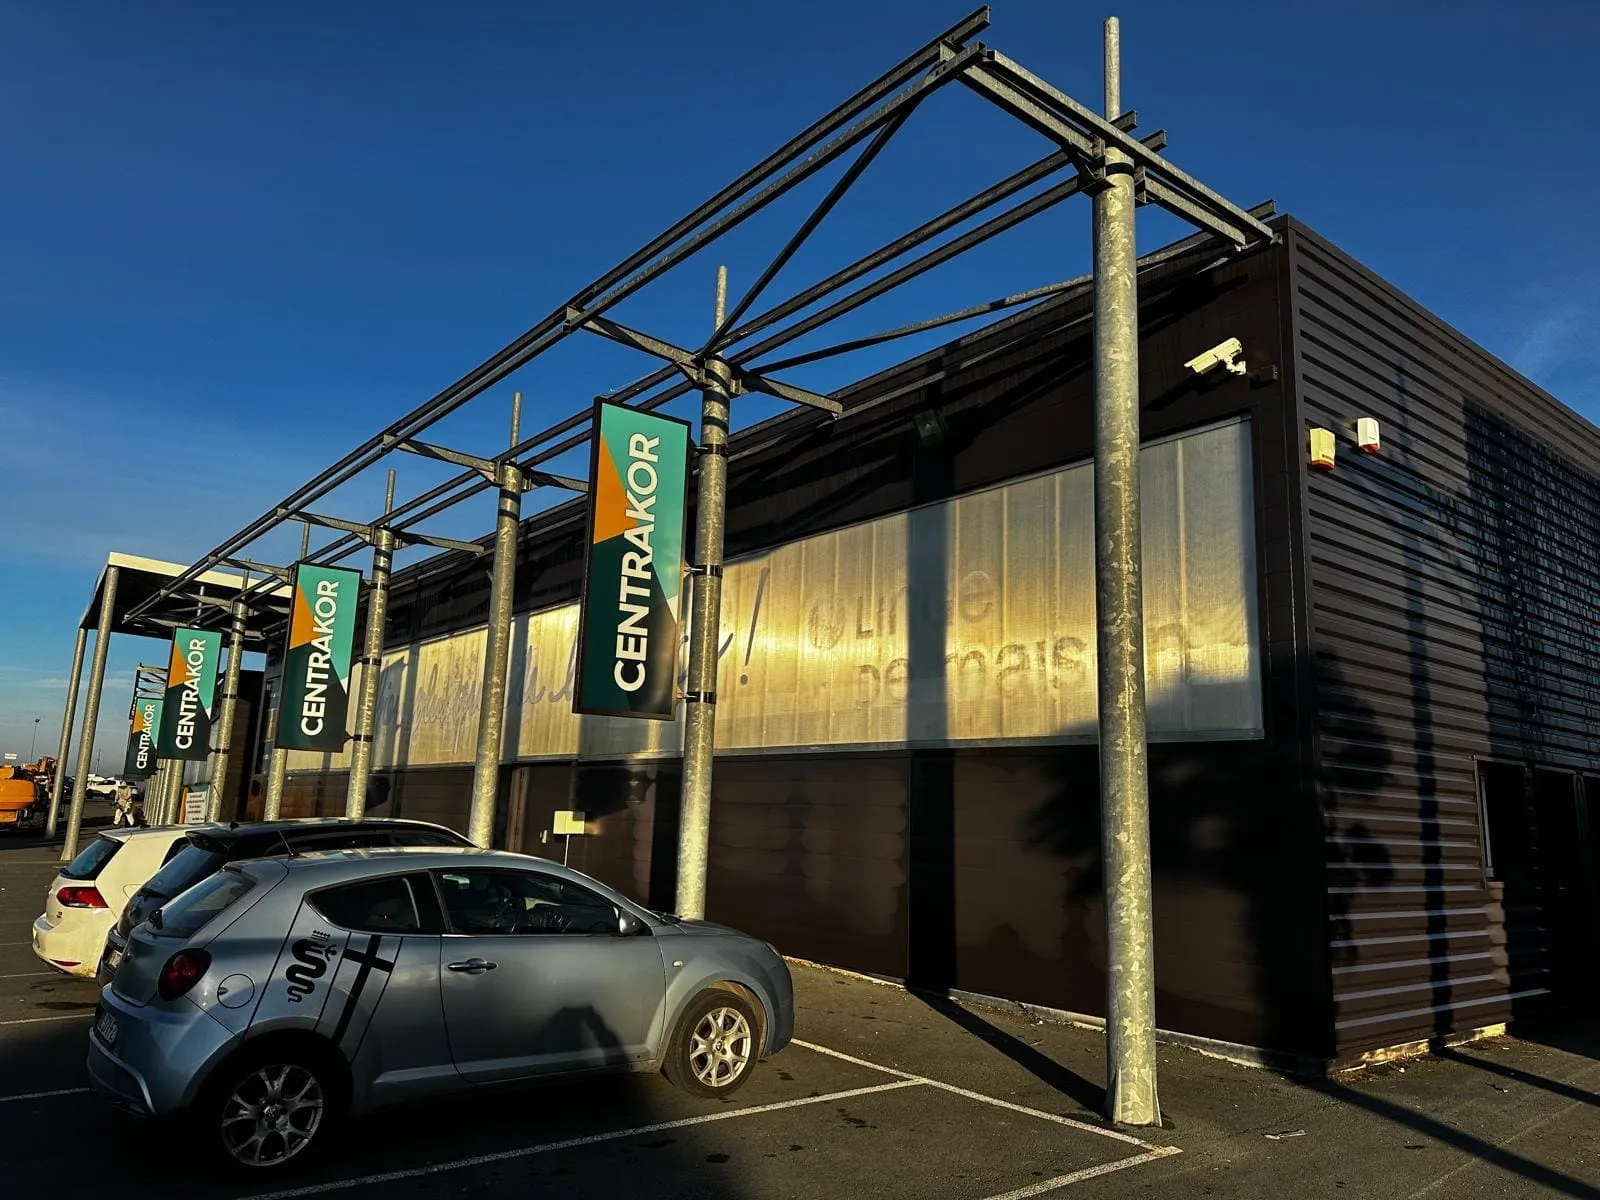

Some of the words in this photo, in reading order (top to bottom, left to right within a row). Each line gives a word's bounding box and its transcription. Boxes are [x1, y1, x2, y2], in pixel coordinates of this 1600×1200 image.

[614, 432, 660, 693] CENTRAKOR
[175, 639, 206, 750] CENTRAKOR
[300, 579, 340, 736] CENTRAKOR
[136, 704, 156, 770] CENTRAKOR
